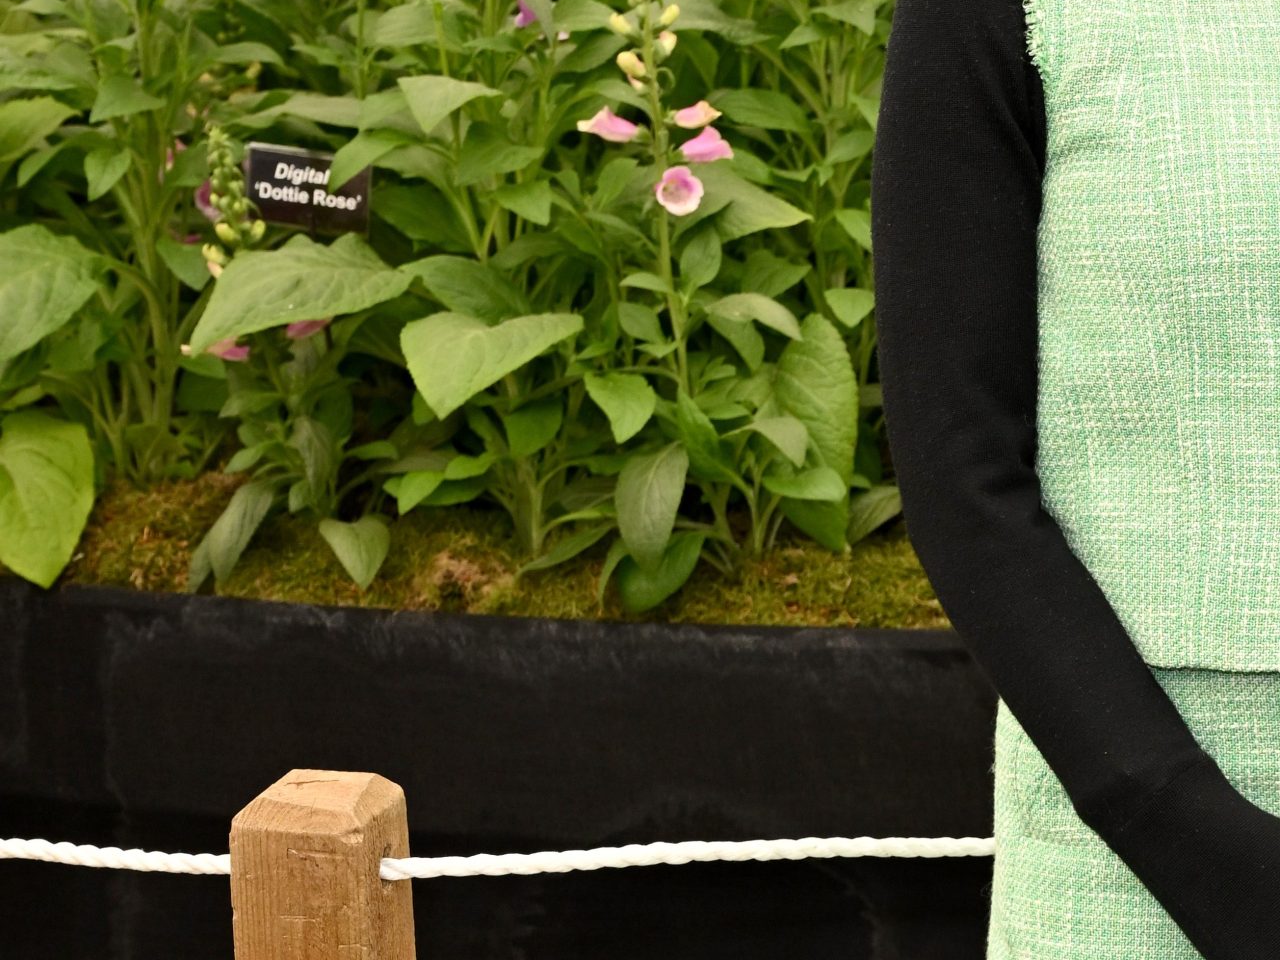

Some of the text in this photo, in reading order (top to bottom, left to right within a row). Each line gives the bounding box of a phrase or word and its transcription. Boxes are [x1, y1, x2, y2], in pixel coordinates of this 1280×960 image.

[274, 162, 332, 185] Digital
[254, 181, 362, 211] ‘Dottie Rose’
